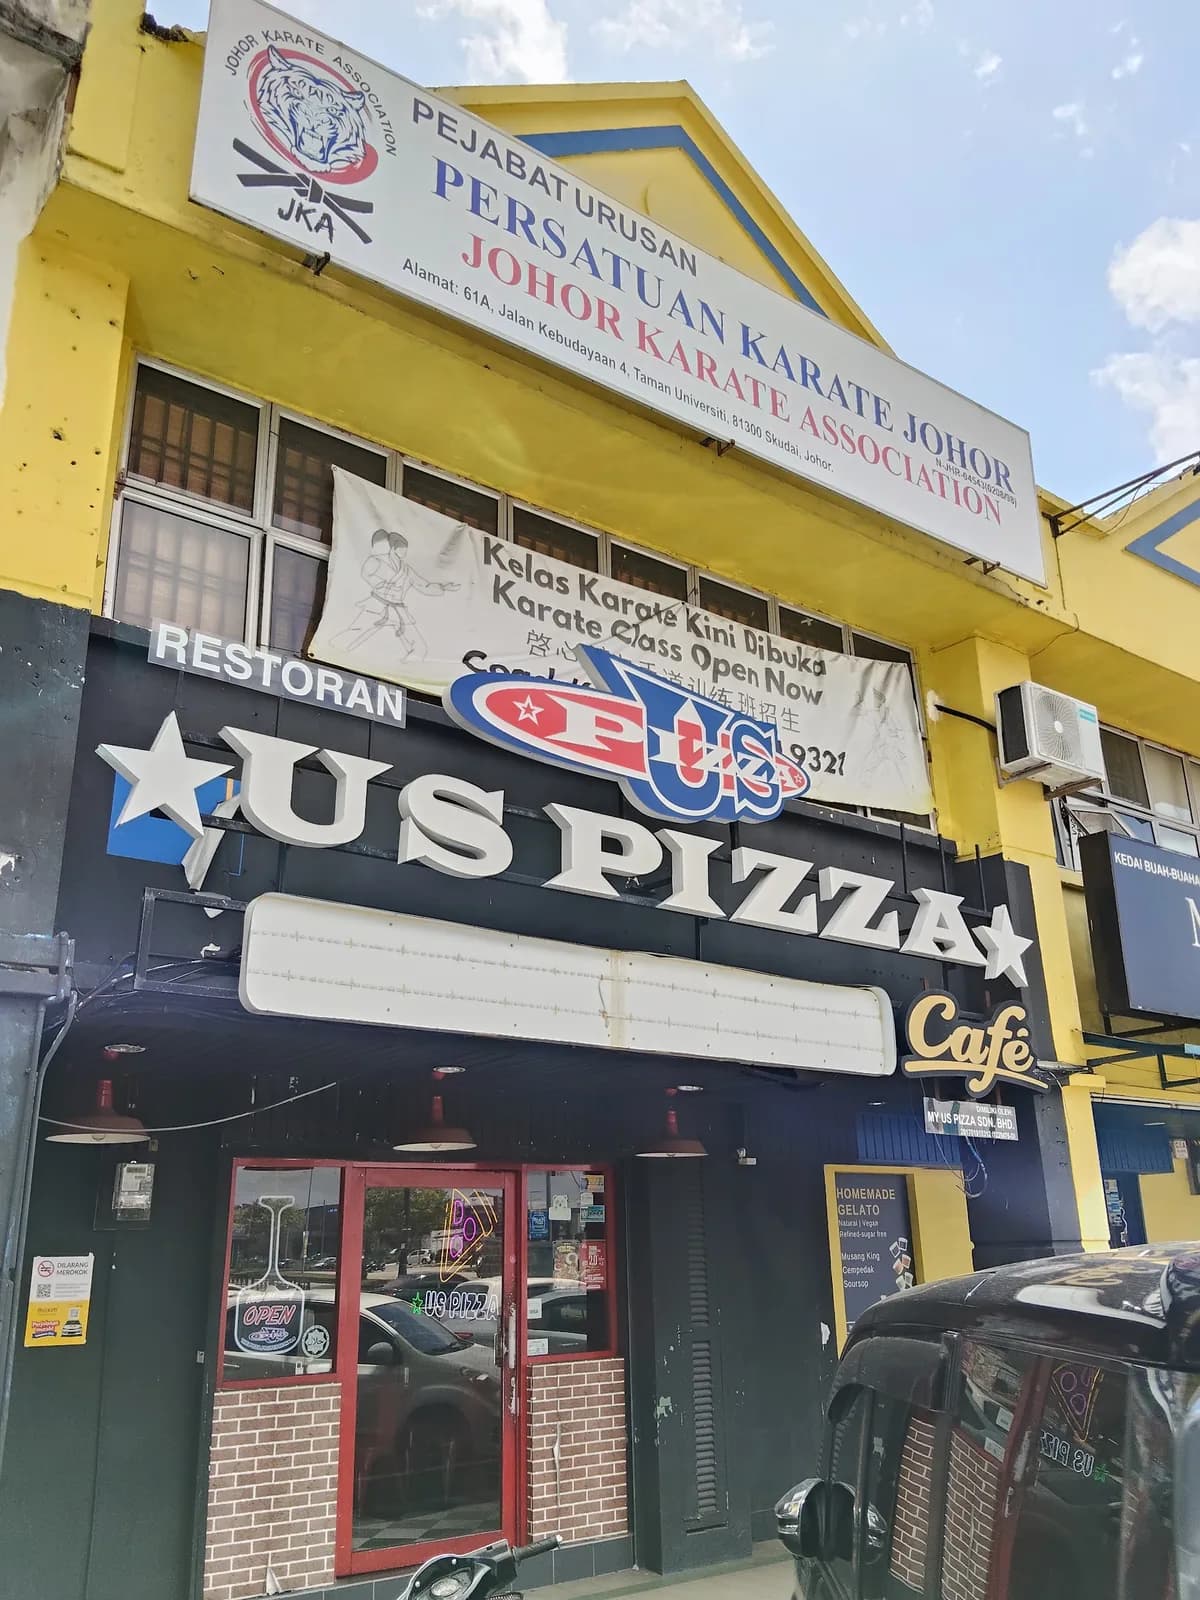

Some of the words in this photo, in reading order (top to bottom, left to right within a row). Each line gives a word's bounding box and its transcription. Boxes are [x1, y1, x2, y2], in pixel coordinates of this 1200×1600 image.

[224, 34, 259, 76] JOHOR
[261, 30, 325, 55] KARATE
[332, 55, 397, 157] ASSOCIATION
[277, 198, 335, 243] JKA
[413, 98, 568, 202] PEJABAT
[575, 188, 697, 277] URUSAN
[431, 155, 726, 345] PERSATUAN
[738, 321, 895, 433] KARATE
[903, 412, 1015, 494] JOHOR
[402, 258, 459, 296] Alamat:
[463, 286, 495, 314] 61A,
[498, 303, 535, 331] Jalan
[538, 321, 616, 370] Kebudayaan
[619, 362, 631, 378] 4,
[633, 366, 672, 396] Taman
[674, 387, 730, 424] Universiti,
[732, 415, 763, 438] 81300
[765, 430, 802, 460] Skudai,
[804, 450, 834, 473] Johor.
[461, 232, 624, 342] JOHOR
[636, 316, 791, 424] KARATE
[800, 405, 1002, 527] ASSOCIATION
[483, 536, 570, 596] Kelas
[578, 572, 679, 628] Karate
[685, 607, 737, 650] Kini
[743, 628, 827, 677] Dibuka
[493, 574, 602, 640] Karate
[610, 618, 683, 663] Class
[690, 642, 760, 684] Open
[765, 667, 824, 707] Now
[154, 622, 405, 724] RESTORAN
[217, 725, 514, 880] US
[541, 801, 990, 968] PIZZA
[1113, 851, 1144, 870] KEDAI
[927, 1110, 940, 1123] MY
[941, 1112, 953, 1124] US
[953, 1113, 977, 1127] PIZZA
[977, 1115, 996, 1128] SDN.
[996, 1117, 1016, 1130] BHD.
[836, 1188, 896, 1200] HOMEMADE
[838, 1204, 880, 1216] GELATO
[841, 1252, 865, 1262] Musang
[866, 1252, 880, 1262] King
[843, 1265, 875, 1276] Cempedak
[243, 1304, 297, 1326] OPEN
[424, 1290, 447, 1318] US
[449, 1291, 500, 1321] PIZZA
